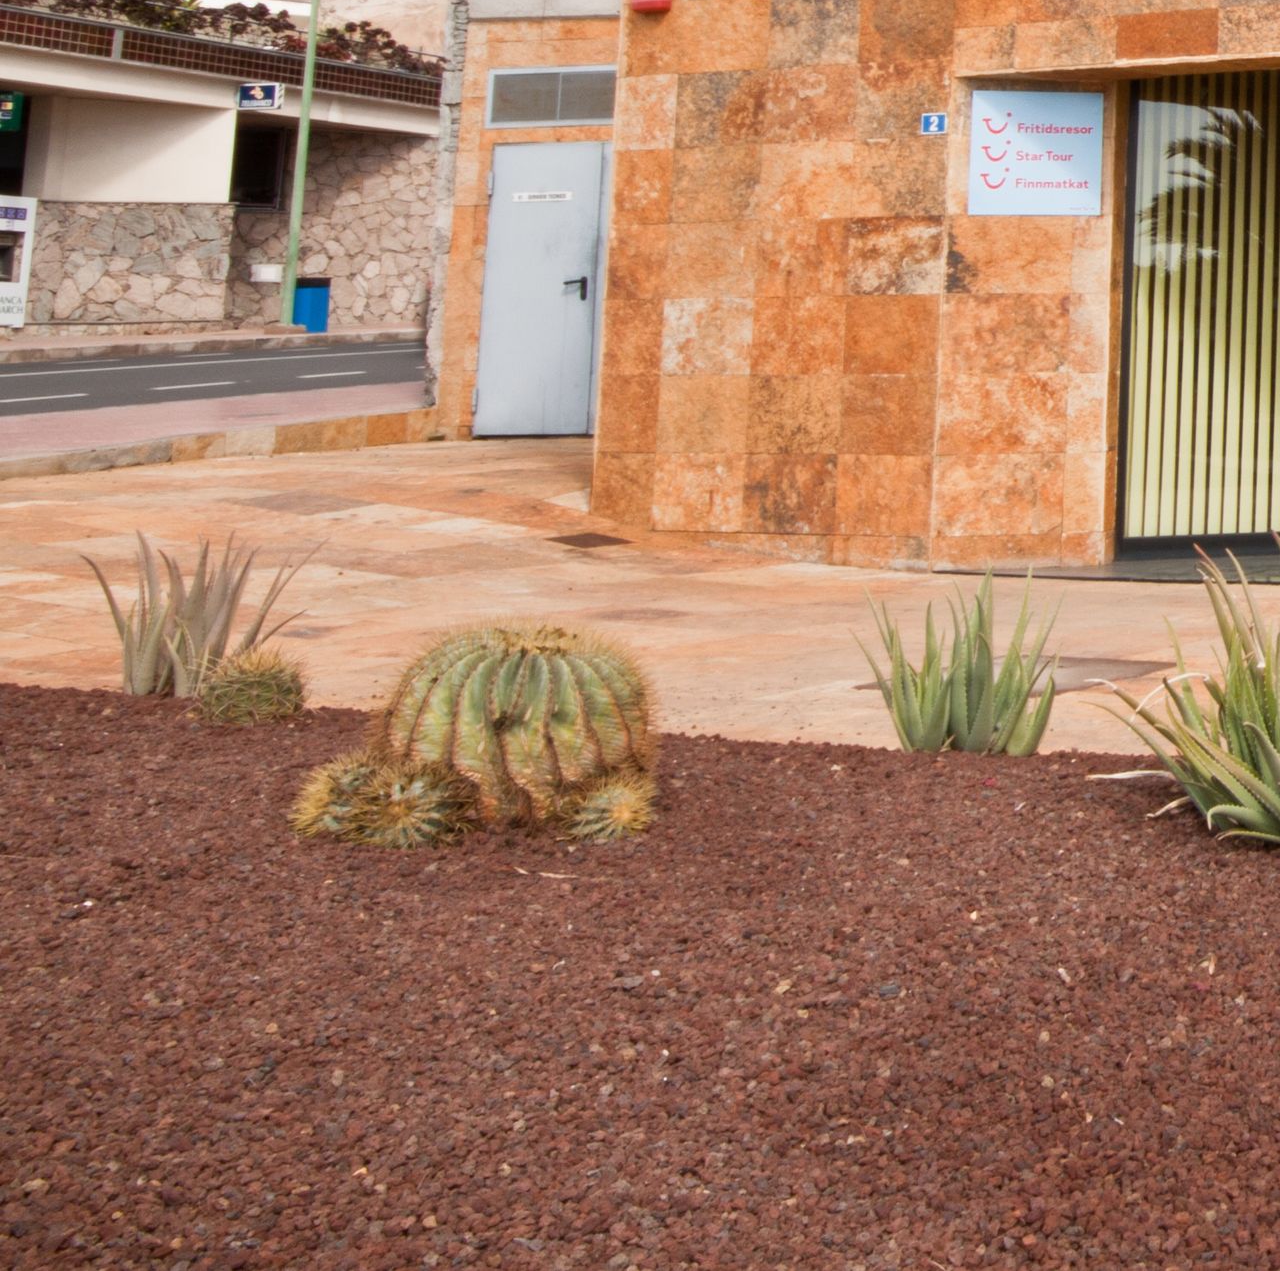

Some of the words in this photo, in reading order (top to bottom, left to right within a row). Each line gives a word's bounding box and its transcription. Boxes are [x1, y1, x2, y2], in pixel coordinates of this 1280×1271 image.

[928, 115, 939, 131] 2
[1017, 122, 1094, 135] Fritidsresor
[1016, 151, 1044, 162] Star
[1047, 151, 1073, 162] Tour
[1015, 178, 1089, 190] Finnmatkat
